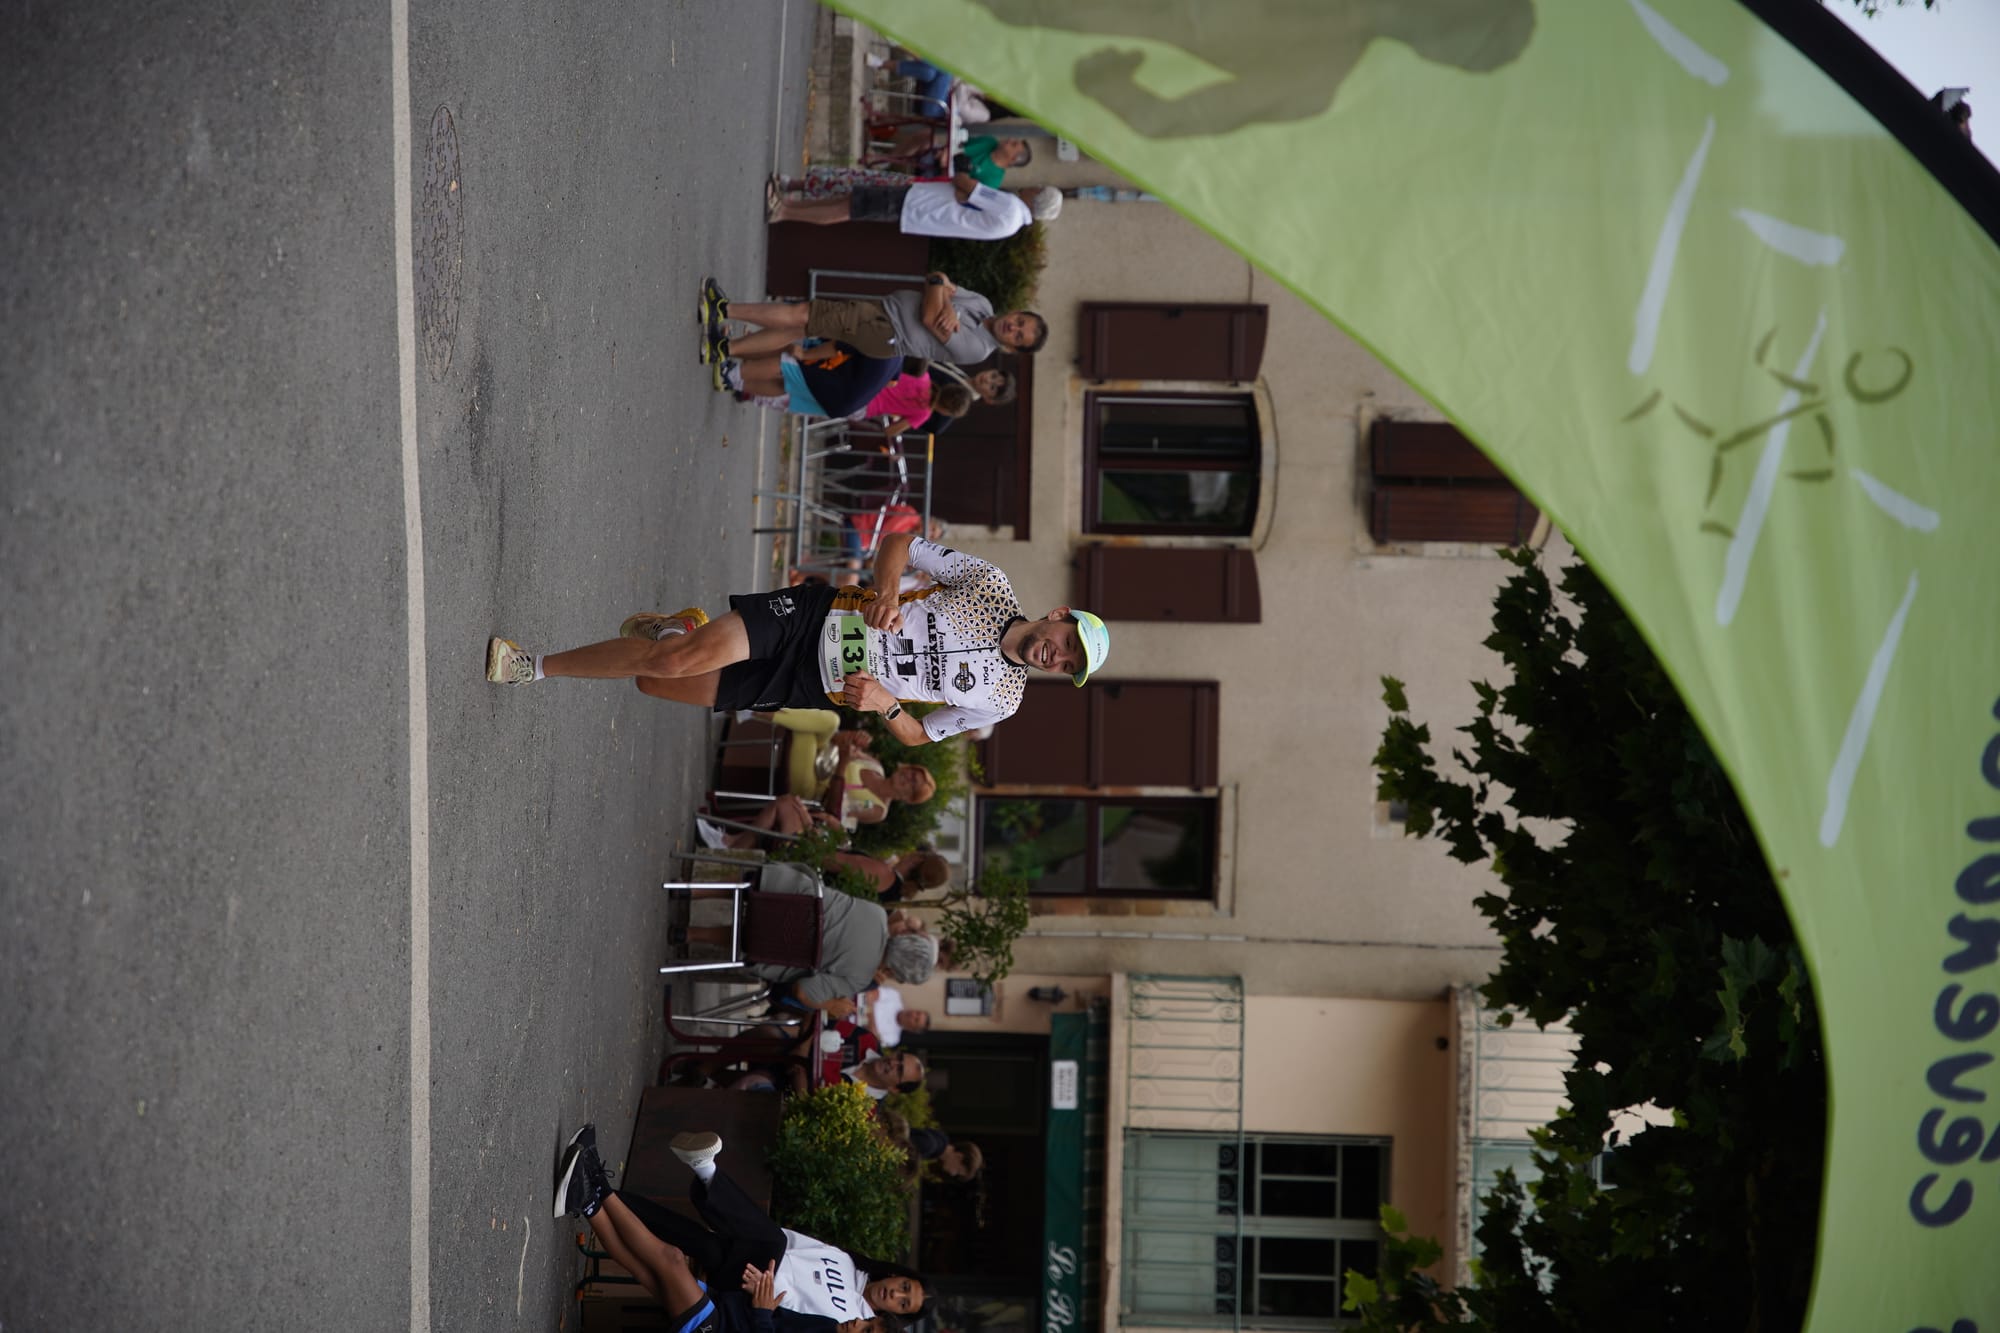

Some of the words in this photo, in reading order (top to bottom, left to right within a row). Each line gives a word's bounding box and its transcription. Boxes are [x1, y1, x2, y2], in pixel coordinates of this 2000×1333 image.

[927, 612, 940, 692] GLEYZON
[936, 631, 946, 651] Jean
[940, 654, 948, 678] Marc
[820, 1258, 846, 1312] LULU
[1047, 1241, 1077, 1285] Le
